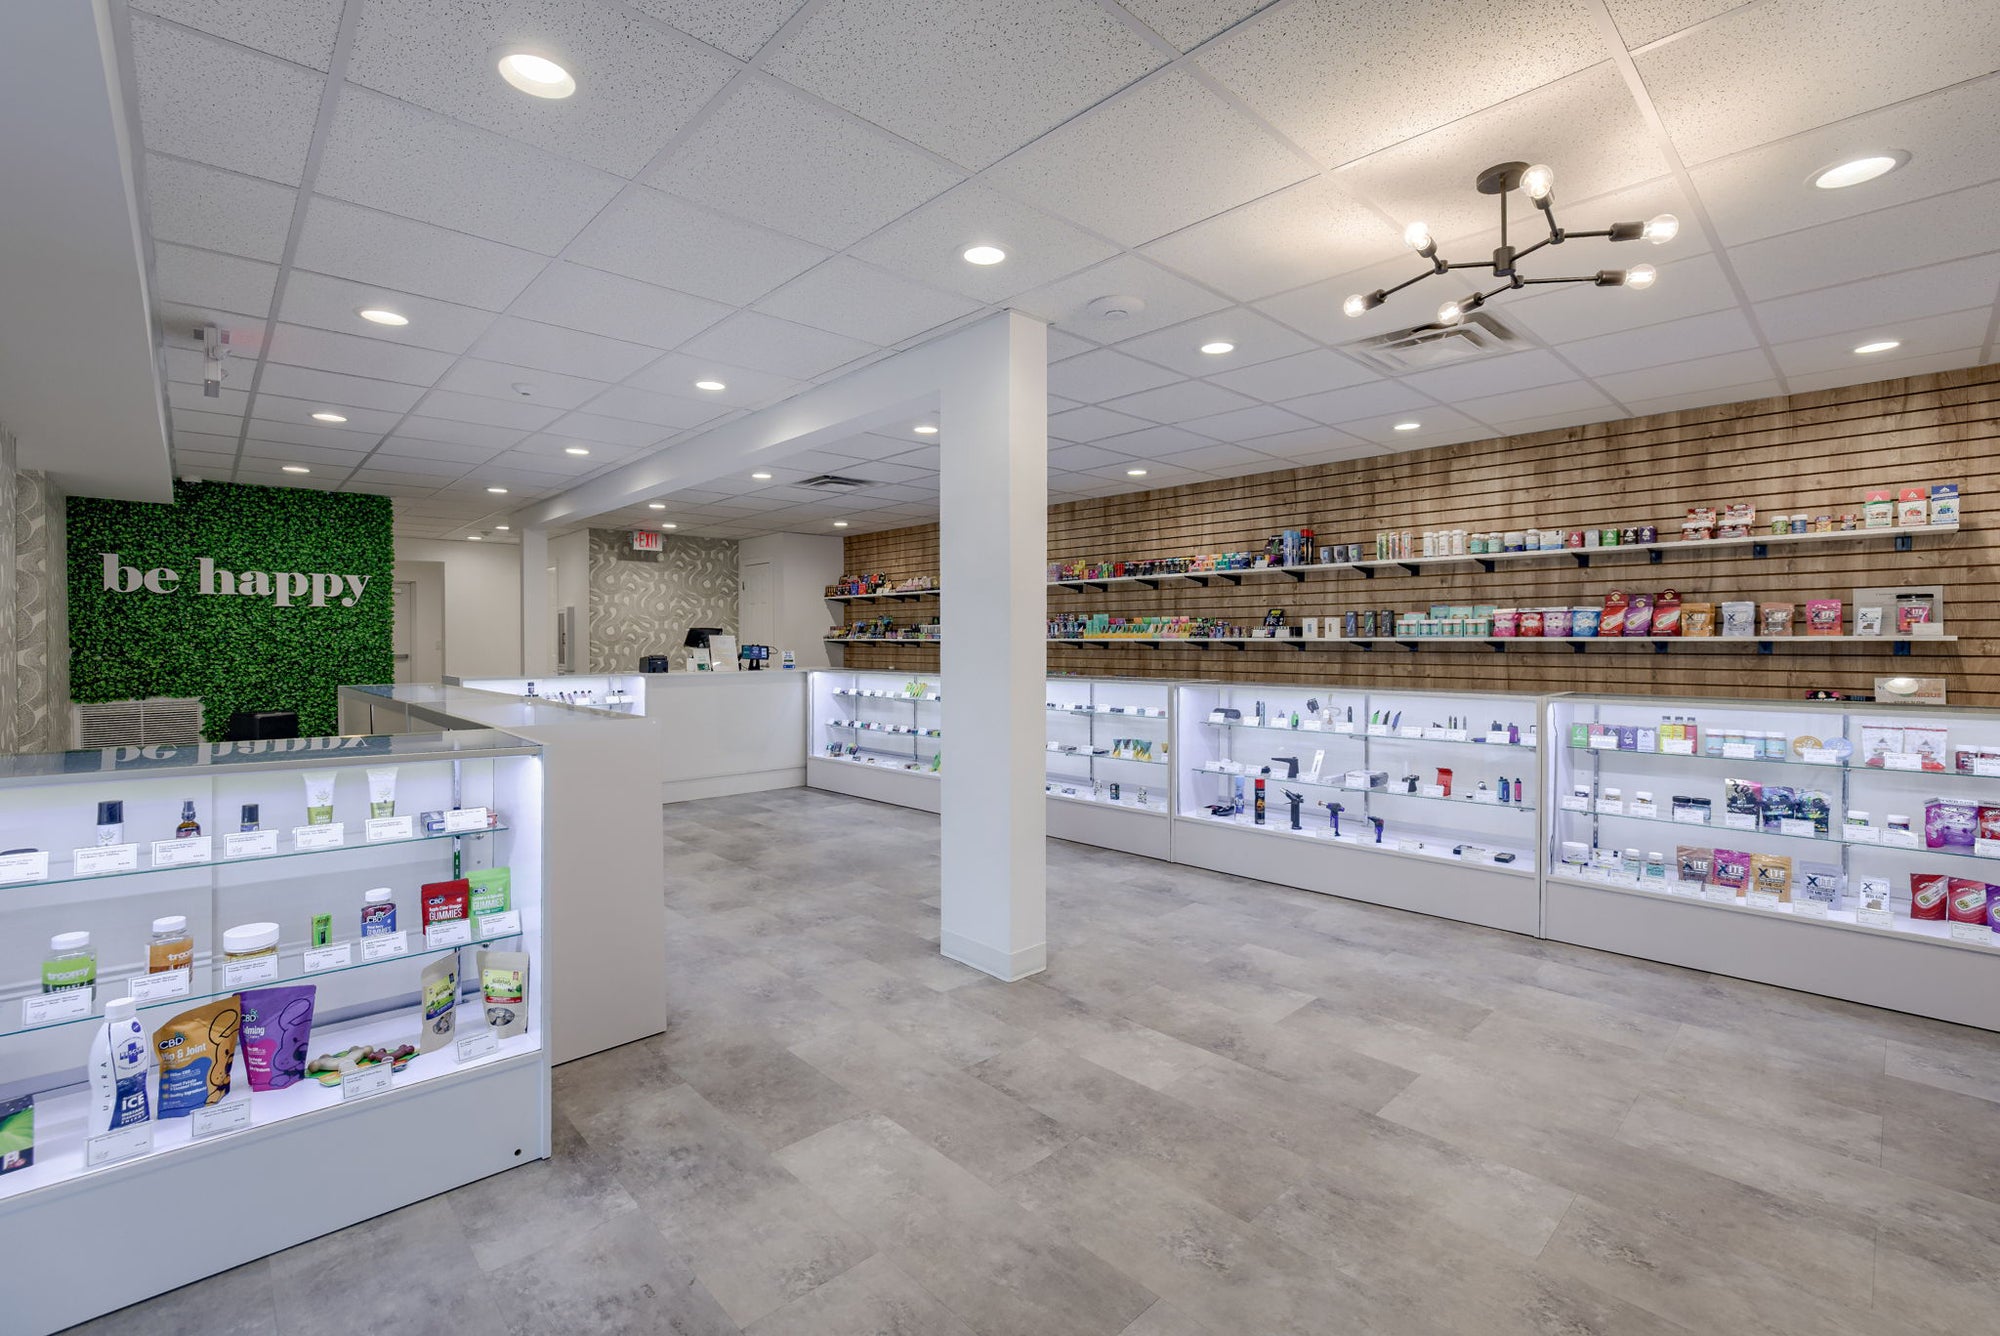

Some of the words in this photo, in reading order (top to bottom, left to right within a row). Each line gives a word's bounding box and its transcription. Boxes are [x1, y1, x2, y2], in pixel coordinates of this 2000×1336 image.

[638, 531, 658, 548] EXIT
[99, 552, 180, 595] be
[195, 556, 373, 608] happy
[1717, 863, 1745, 876] XITE
[1758, 866, 1786, 879] XITE
[429, 909, 463, 921] GUMMIES
[47, 967, 90, 981] troomy
[159, 1036, 184, 1050] CBD
[177, 1048, 184, 1059] &
[186, 1043, 206, 1057] Joint
[101, 1062, 110, 1111] ULTRA
[122, 1095, 145, 1111] ICE
